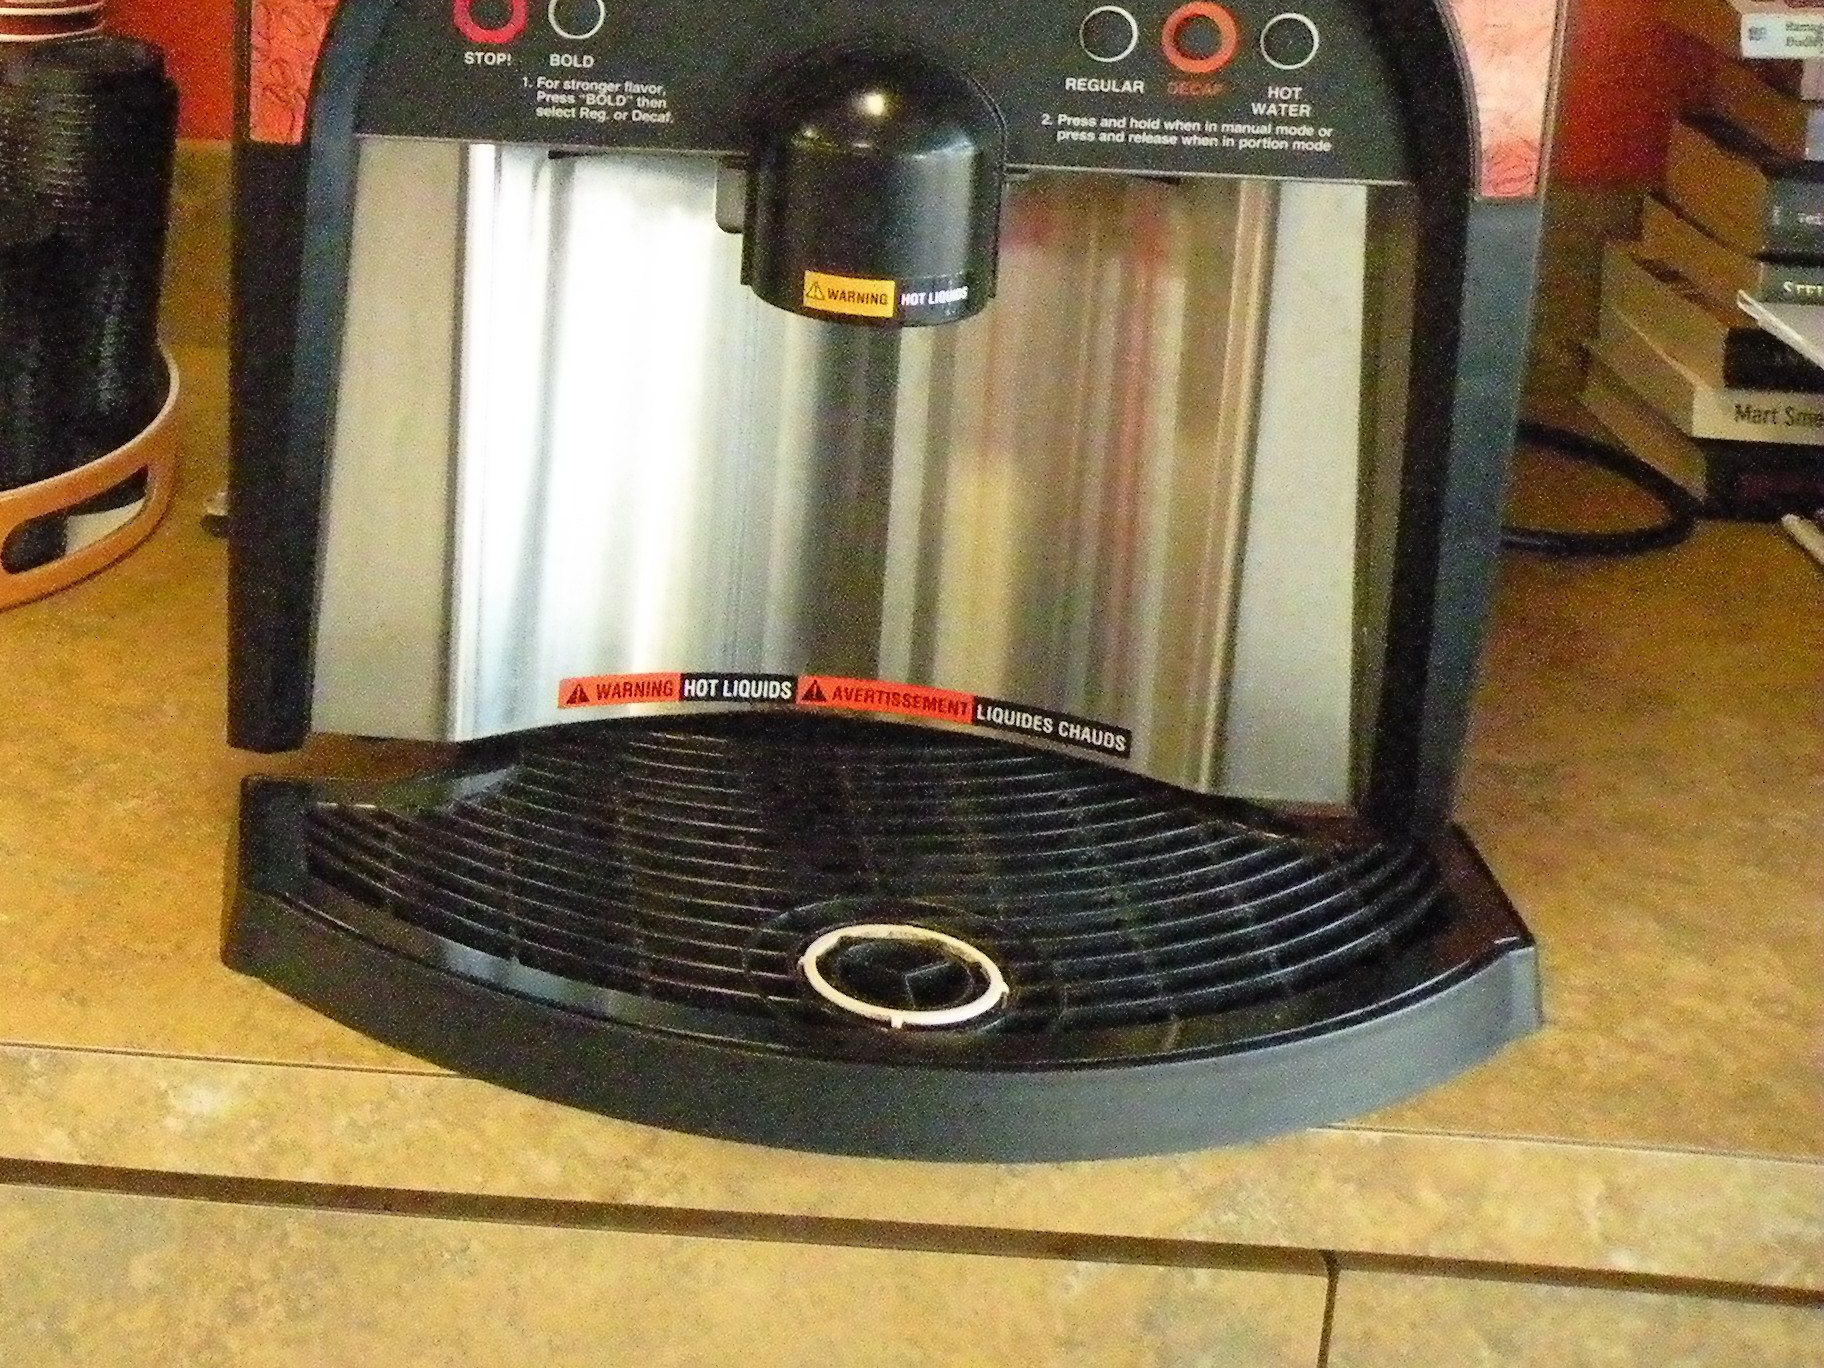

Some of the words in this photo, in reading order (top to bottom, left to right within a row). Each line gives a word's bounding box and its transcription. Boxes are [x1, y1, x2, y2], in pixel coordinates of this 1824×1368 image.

[464, 51, 512, 67] STOP!
[549, 53, 595, 69] BOLD
[523, 77, 534, 88] 1.
[537, 76, 560, 89] For
[563, 80, 621, 94] stronger
[1065, 78, 1145, 94] REGULAR
[1268, 86, 1303, 101] HOT
[536, 90, 576, 104] Press
[636, 96, 668, 109] then
[536, 105, 576, 119] select
[579, 107, 610, 123] Reg.
[613, 110, 628, 121] or
[1251, 102, 1312, 118] WATER
[1058, 114, 1096, 128] Press
[1100, 115, 1126, 129] and
[1129, 117, 1161, 130] hold
[1164, 119, 1201, 132] when
[1205, 120, 1217, 132] in
[1221, 121, 1272, 134] manual
[1276, 123, 1315, 137] mode
[1318, 127, 1334, 138] or
[1056, 130, 1095, 144] press
[1099, 130, 1126, 143] and
[1129, 131, 1178, 146] release
[1181, 134, 1219, 147] when
[1222, 135, 1236, 148] in
[1238, 137, 1289, 152] portion
[1292, 138, 1333, 152] mode
[827, 288, 889, 305] WARNING
[901, 292, 925, 306] HOT
[928, 285, 969, 305] LIQUIDS
[595, 679, 675, 703] WARNING
[683, 678, 720, 698] HOT
[723, 678, 793, 700] LIQUIDS
[831, 685, 971, 718] AVERTISSEMENT
[978, 703, 1054, 733] LIQUIDES
[1057, 720, 1128, 753] CHAUDS
